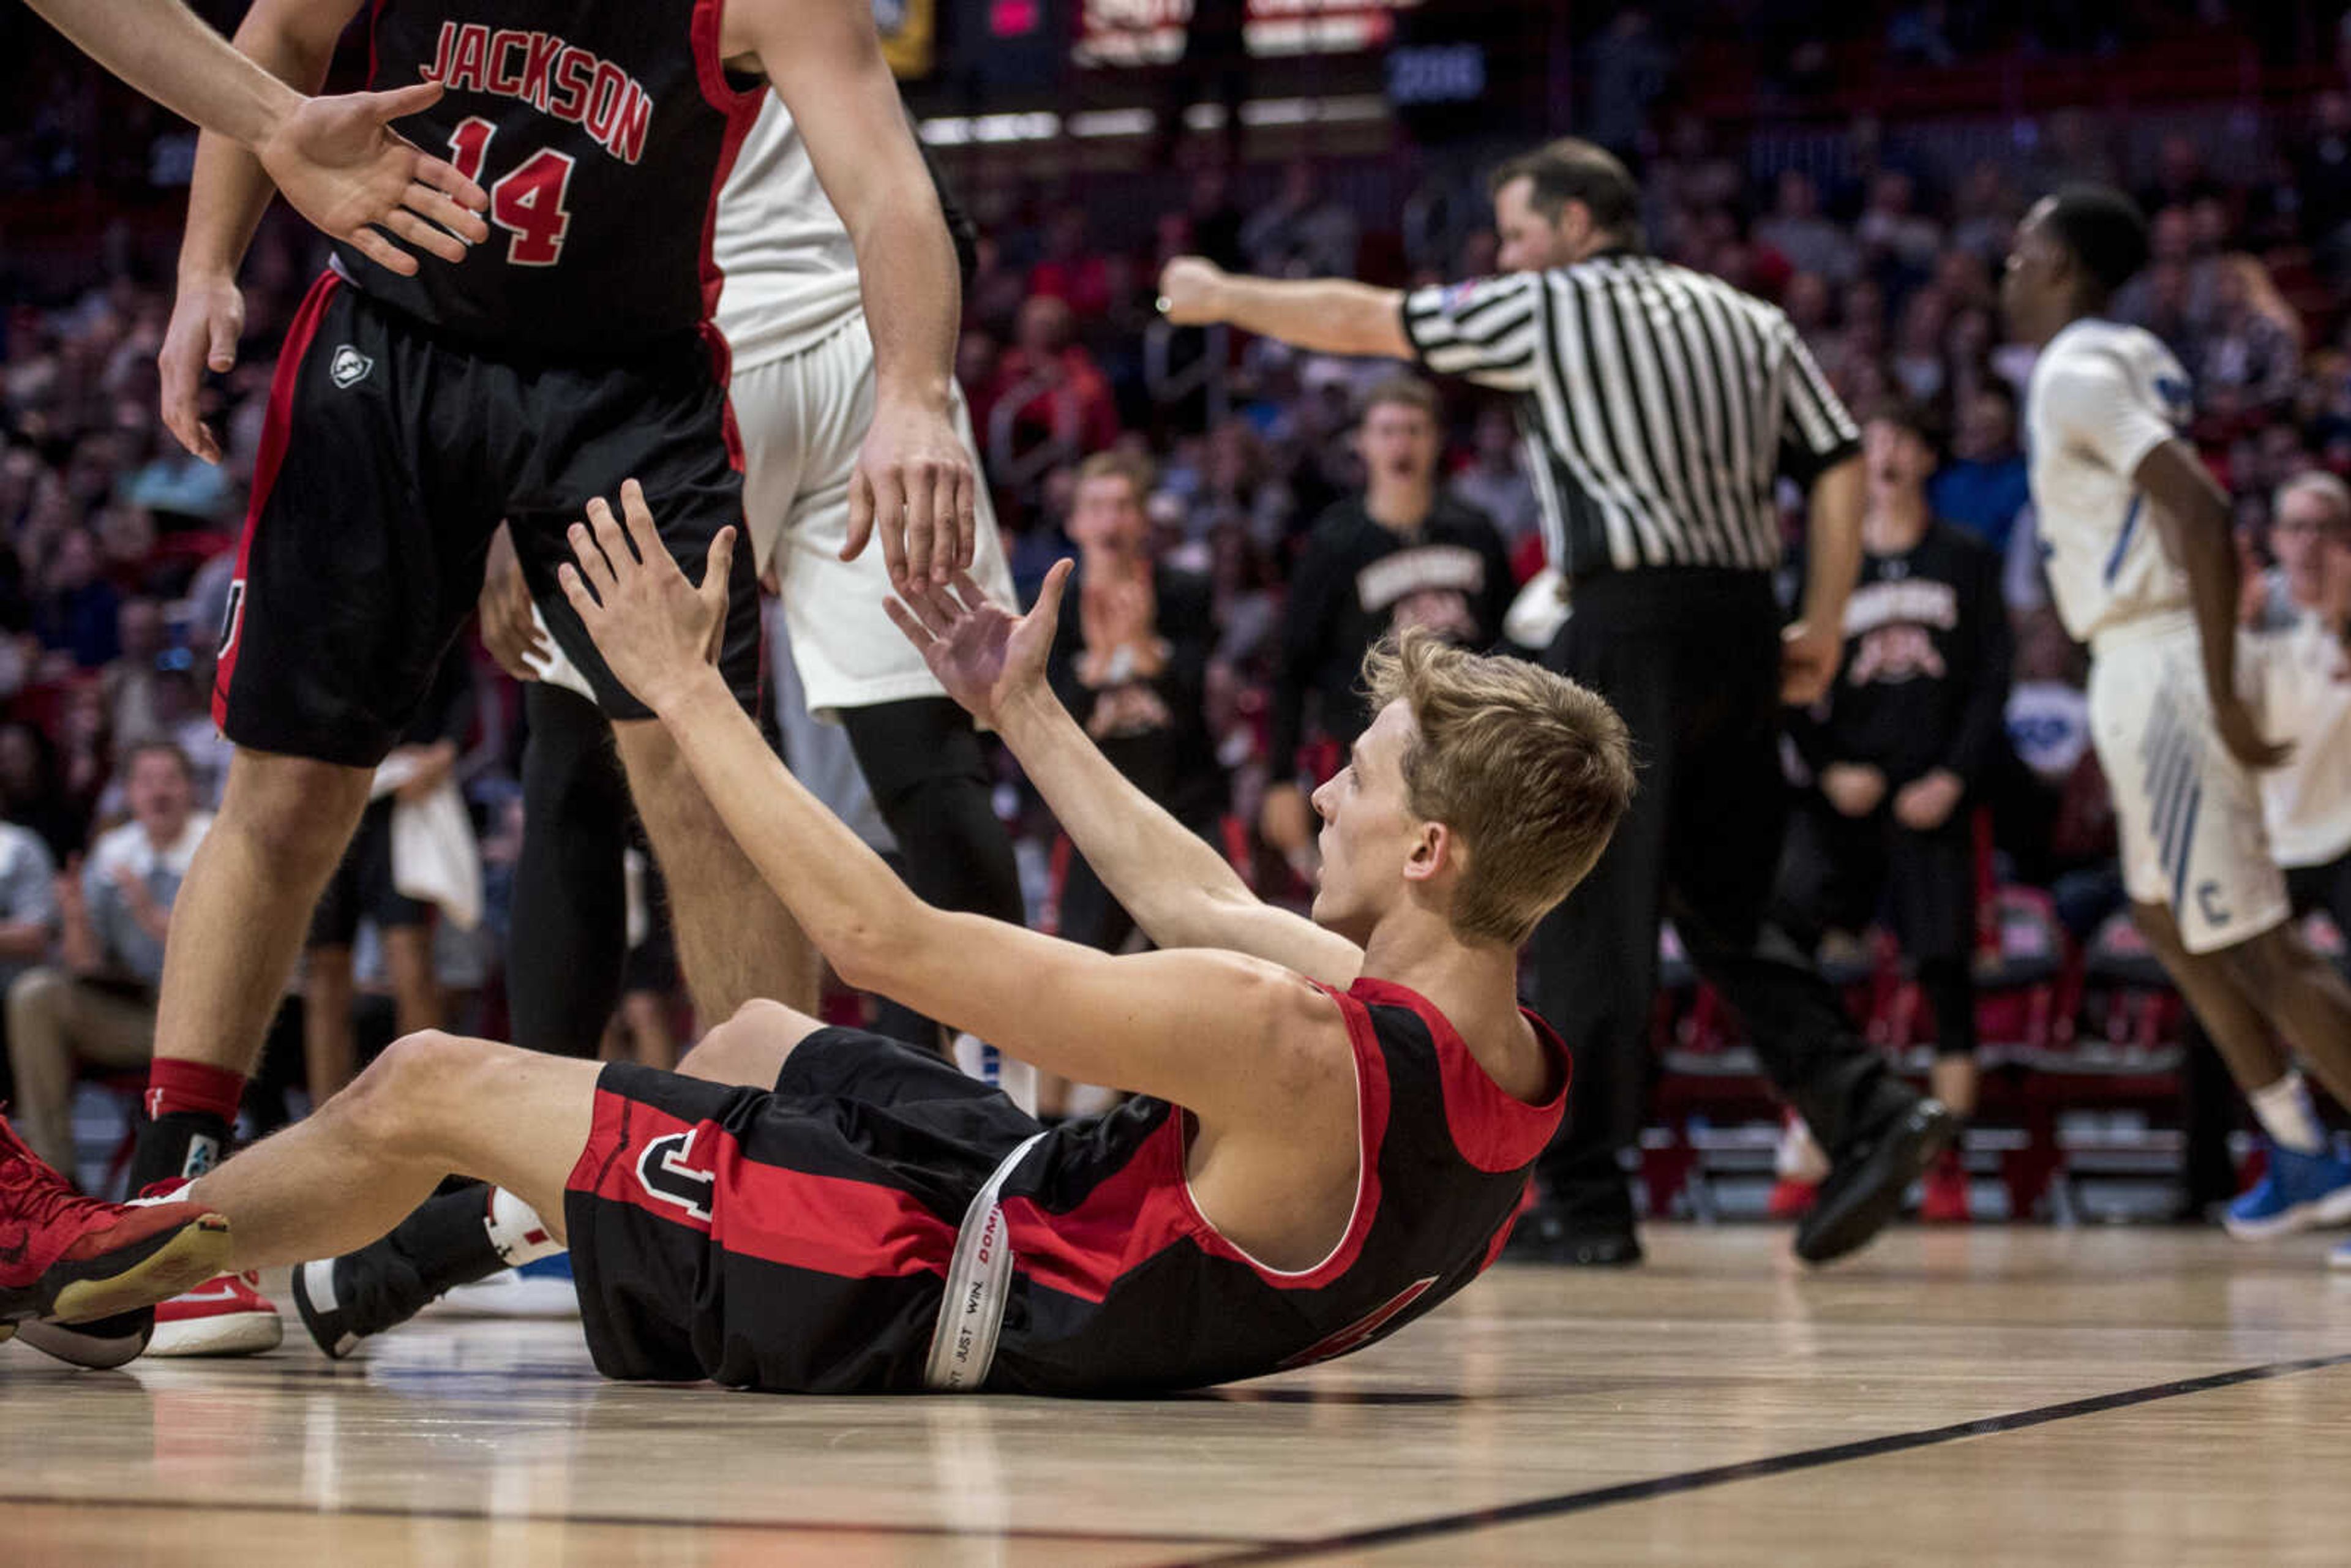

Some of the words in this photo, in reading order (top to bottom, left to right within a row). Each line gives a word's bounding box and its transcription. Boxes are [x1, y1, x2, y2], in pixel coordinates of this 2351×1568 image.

[419, 21, 654, 165] JACKSON
[447, 116, 576, 267] 14
[955, 1326, 973, 1364] JUST
